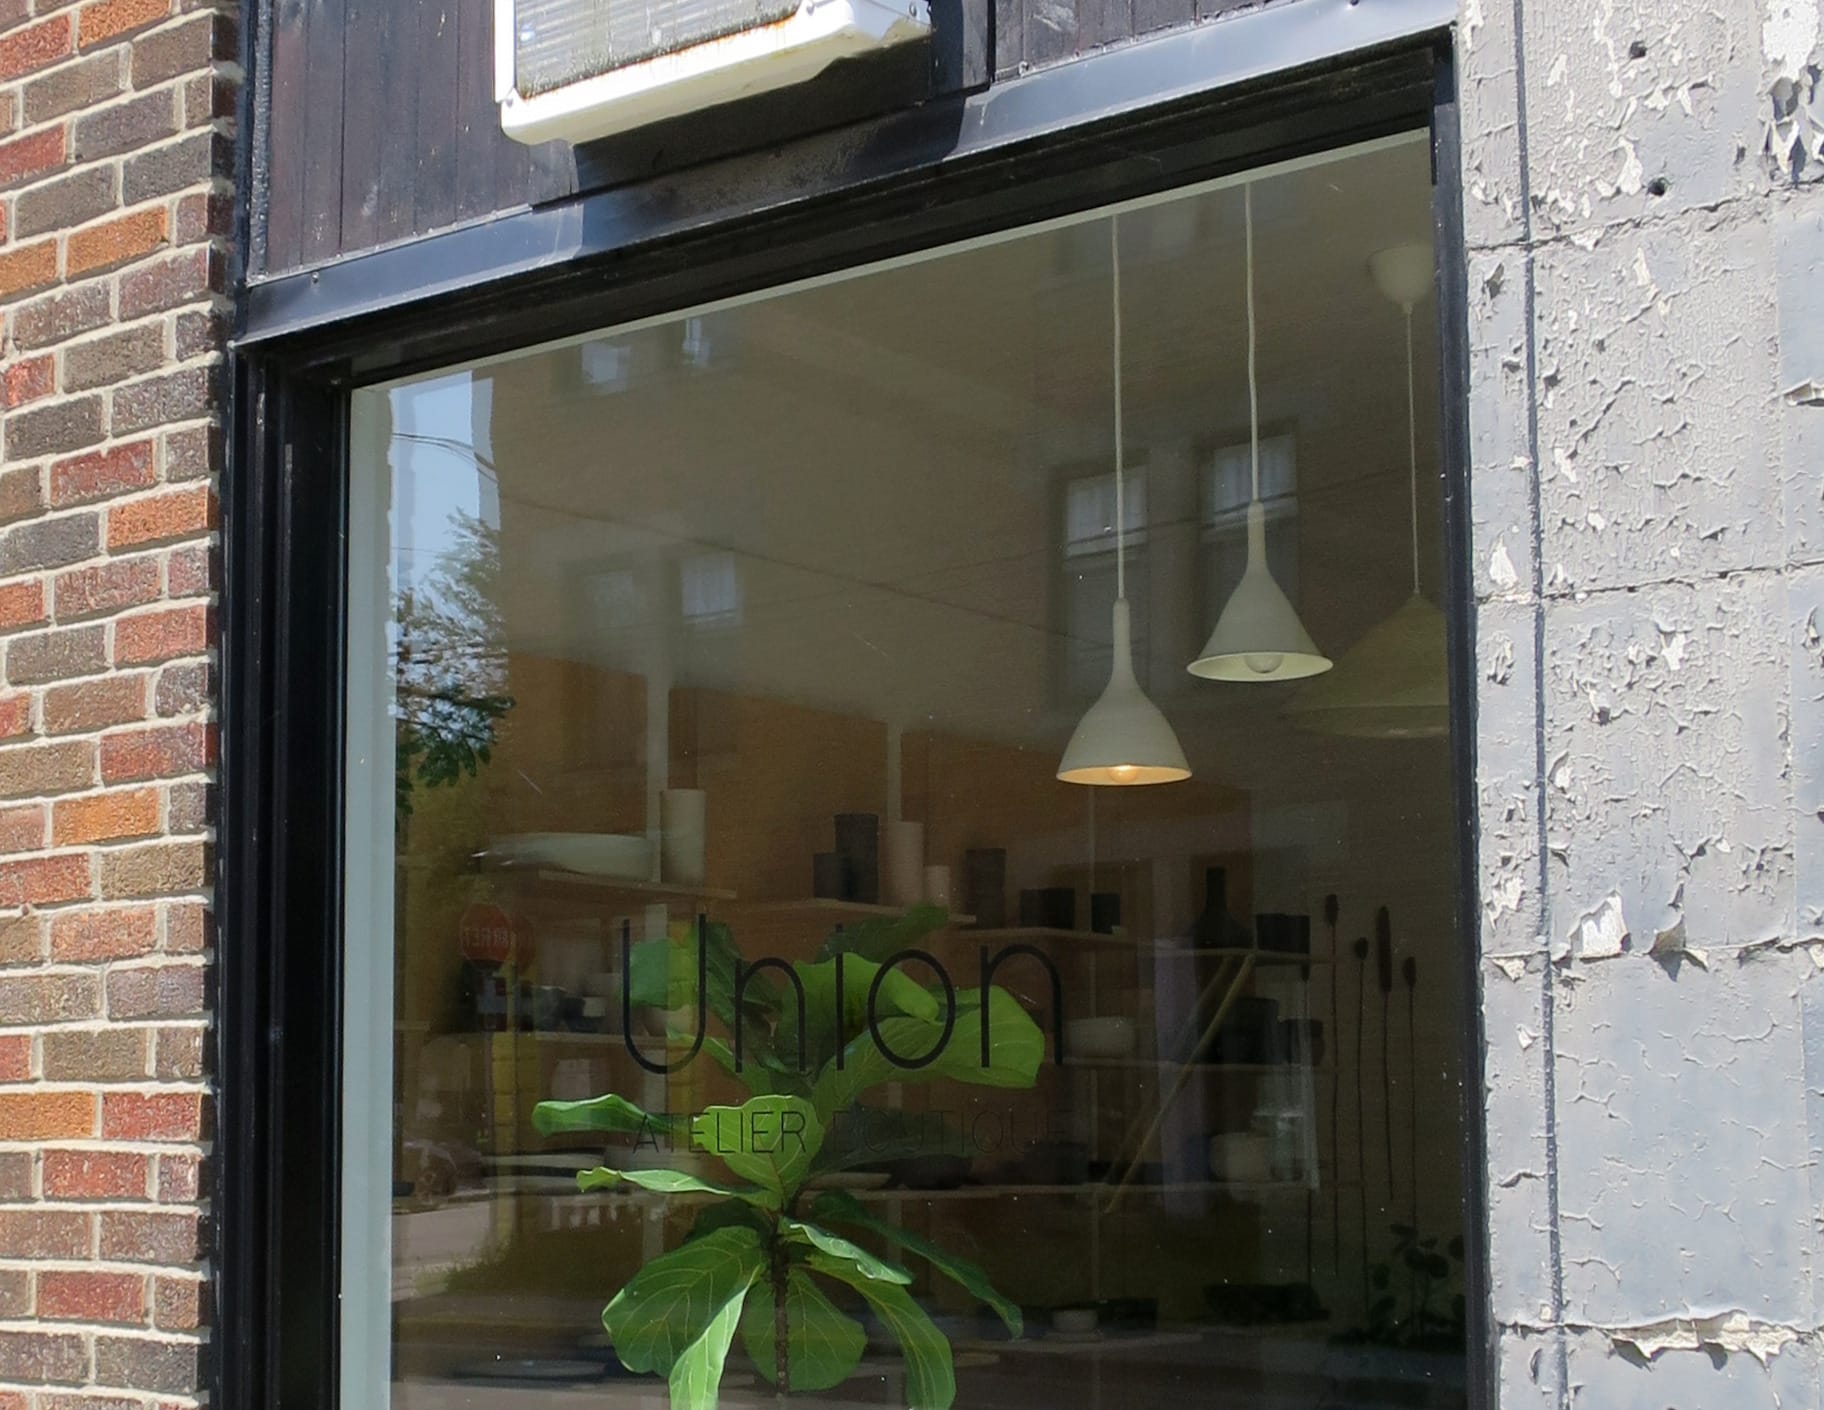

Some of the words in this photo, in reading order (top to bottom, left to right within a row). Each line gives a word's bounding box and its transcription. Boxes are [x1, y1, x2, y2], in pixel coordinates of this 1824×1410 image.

[621, 912, 1064, 1074] Union
[632, 1110, 806, 1154] ATELIER
[831, 1109, 1073, 1155] BOUTIQUE
